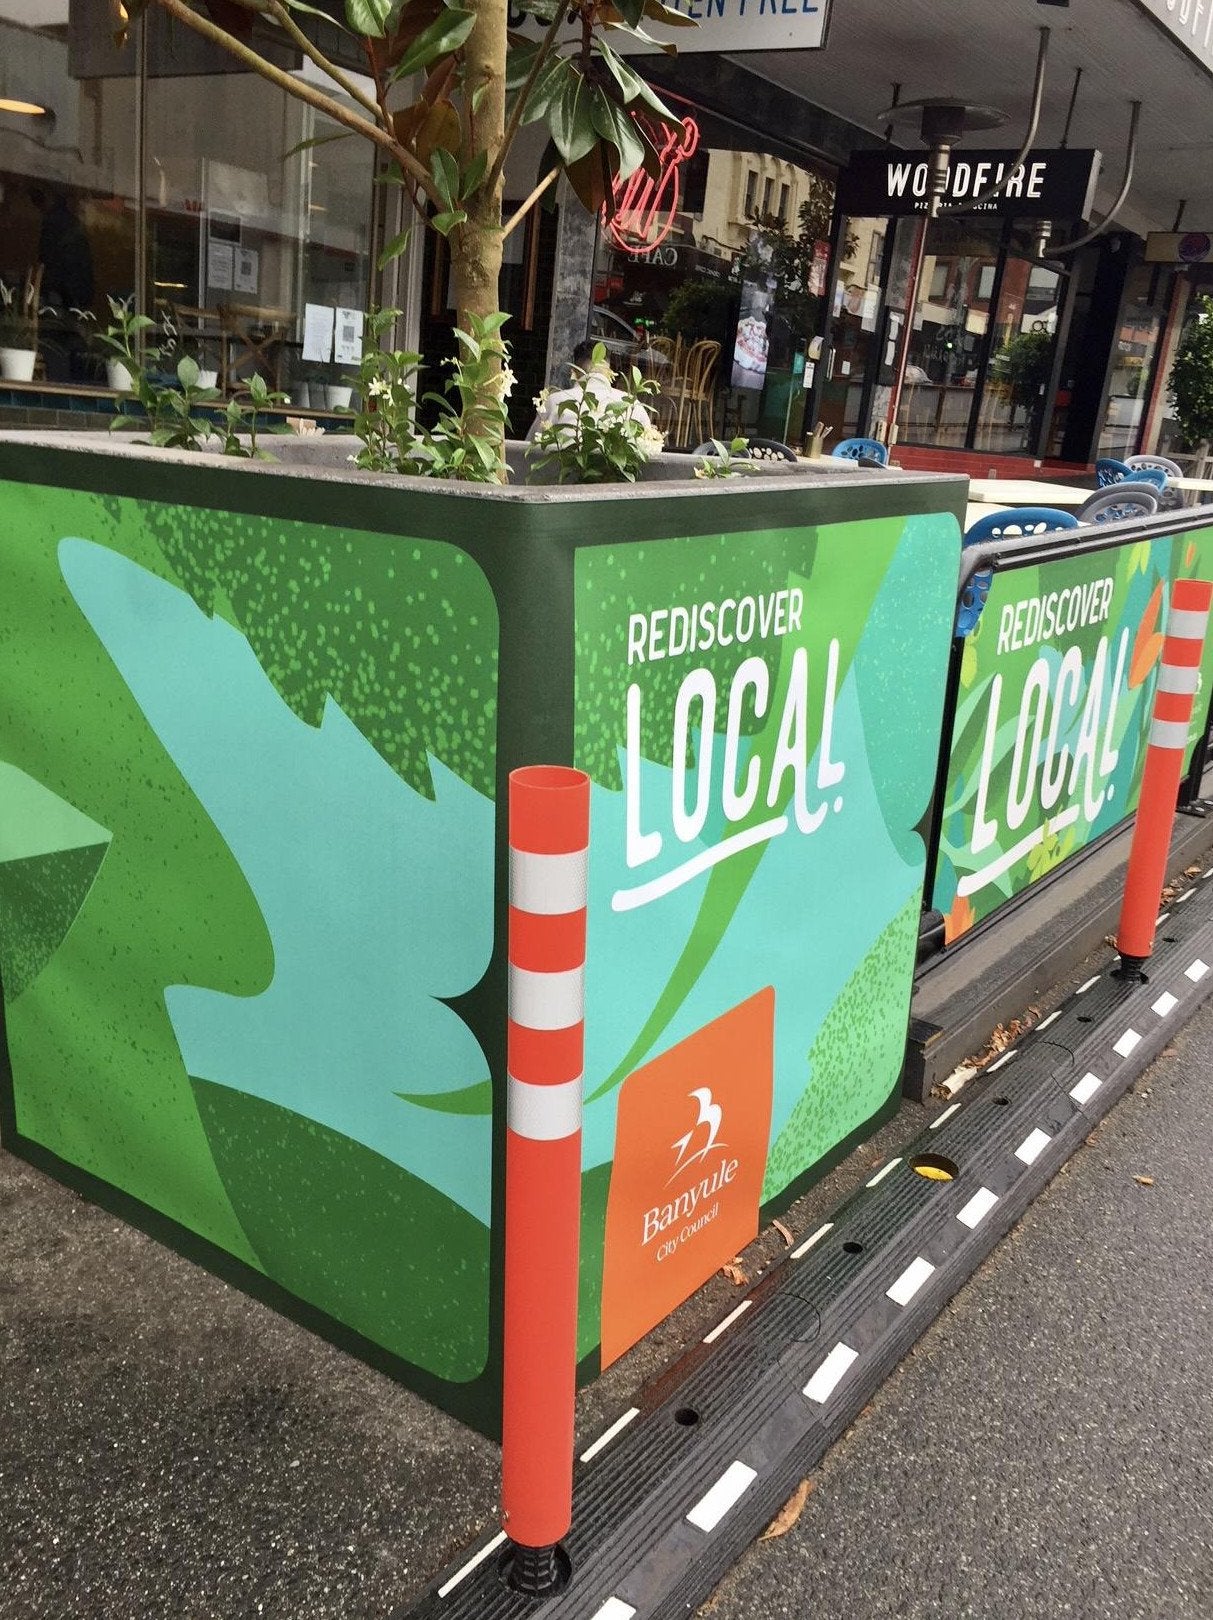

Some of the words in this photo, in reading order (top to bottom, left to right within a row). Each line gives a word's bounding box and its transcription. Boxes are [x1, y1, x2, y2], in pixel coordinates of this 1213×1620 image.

[886, 162, 1047, 198] WODFIRE
[627, 588, 804, 665] REDISCOVER
[997, 577, 1114, 655] REDISCOVER
[641, 1158, 739, 1247] Banyule
[656, 1235, 681, 1262] City
[680, 1202, 719, 1243] Council
